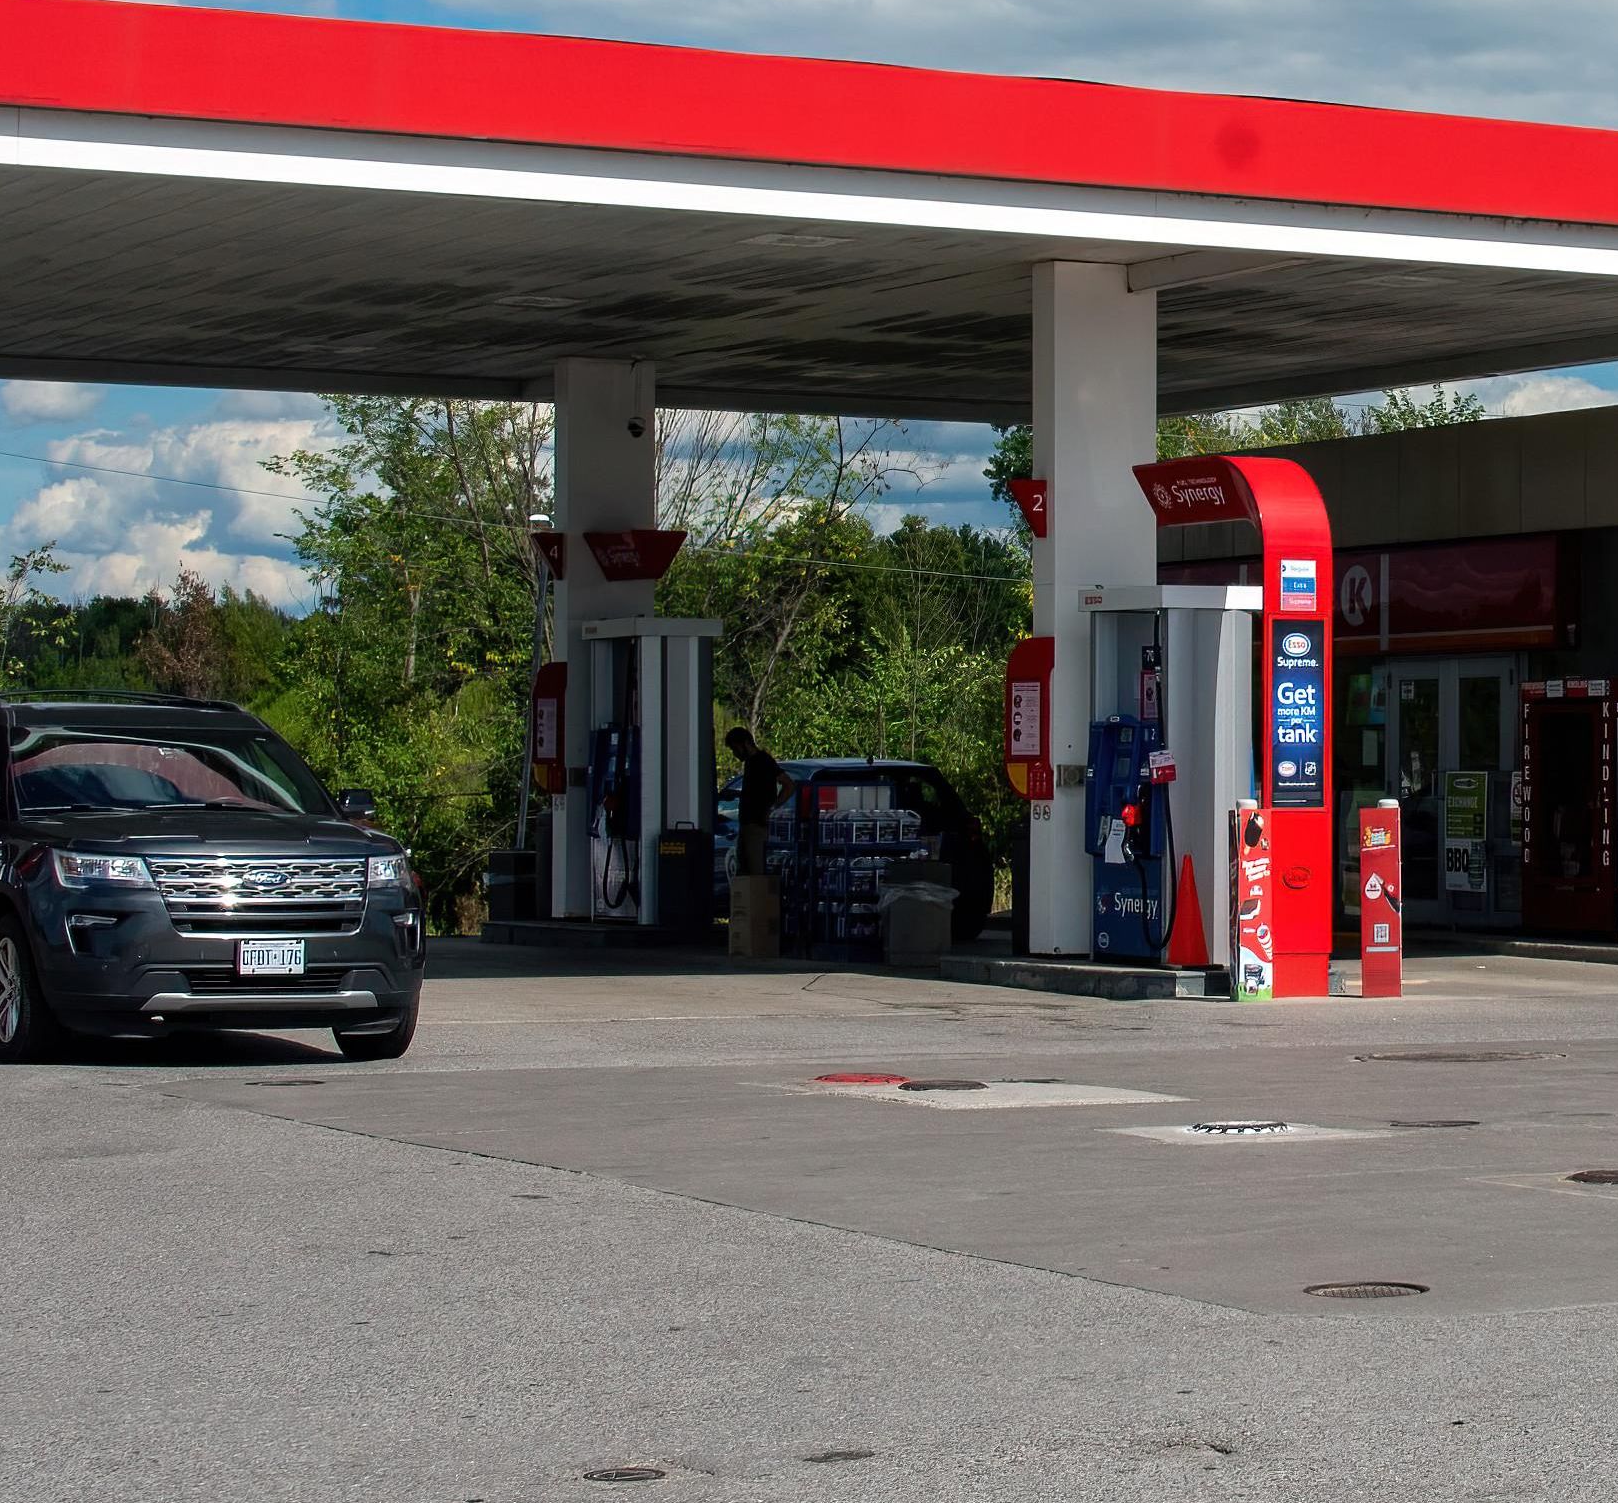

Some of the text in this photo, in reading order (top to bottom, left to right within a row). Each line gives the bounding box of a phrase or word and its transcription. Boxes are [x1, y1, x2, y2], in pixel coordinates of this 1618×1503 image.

[1032, 494, 1043, 511] 2
[1171, 485, 1226, 507] Synergy
[549, 545, 558, 559] 4
[1348, 577, 1369, 620] K
[1277, 682, 1316, 705] Get
[1277, 706, 1316, 716] more KM
[1277, 723, 1317, 743] tank
[1522, 703, 1532, 863] FIREWOOD
